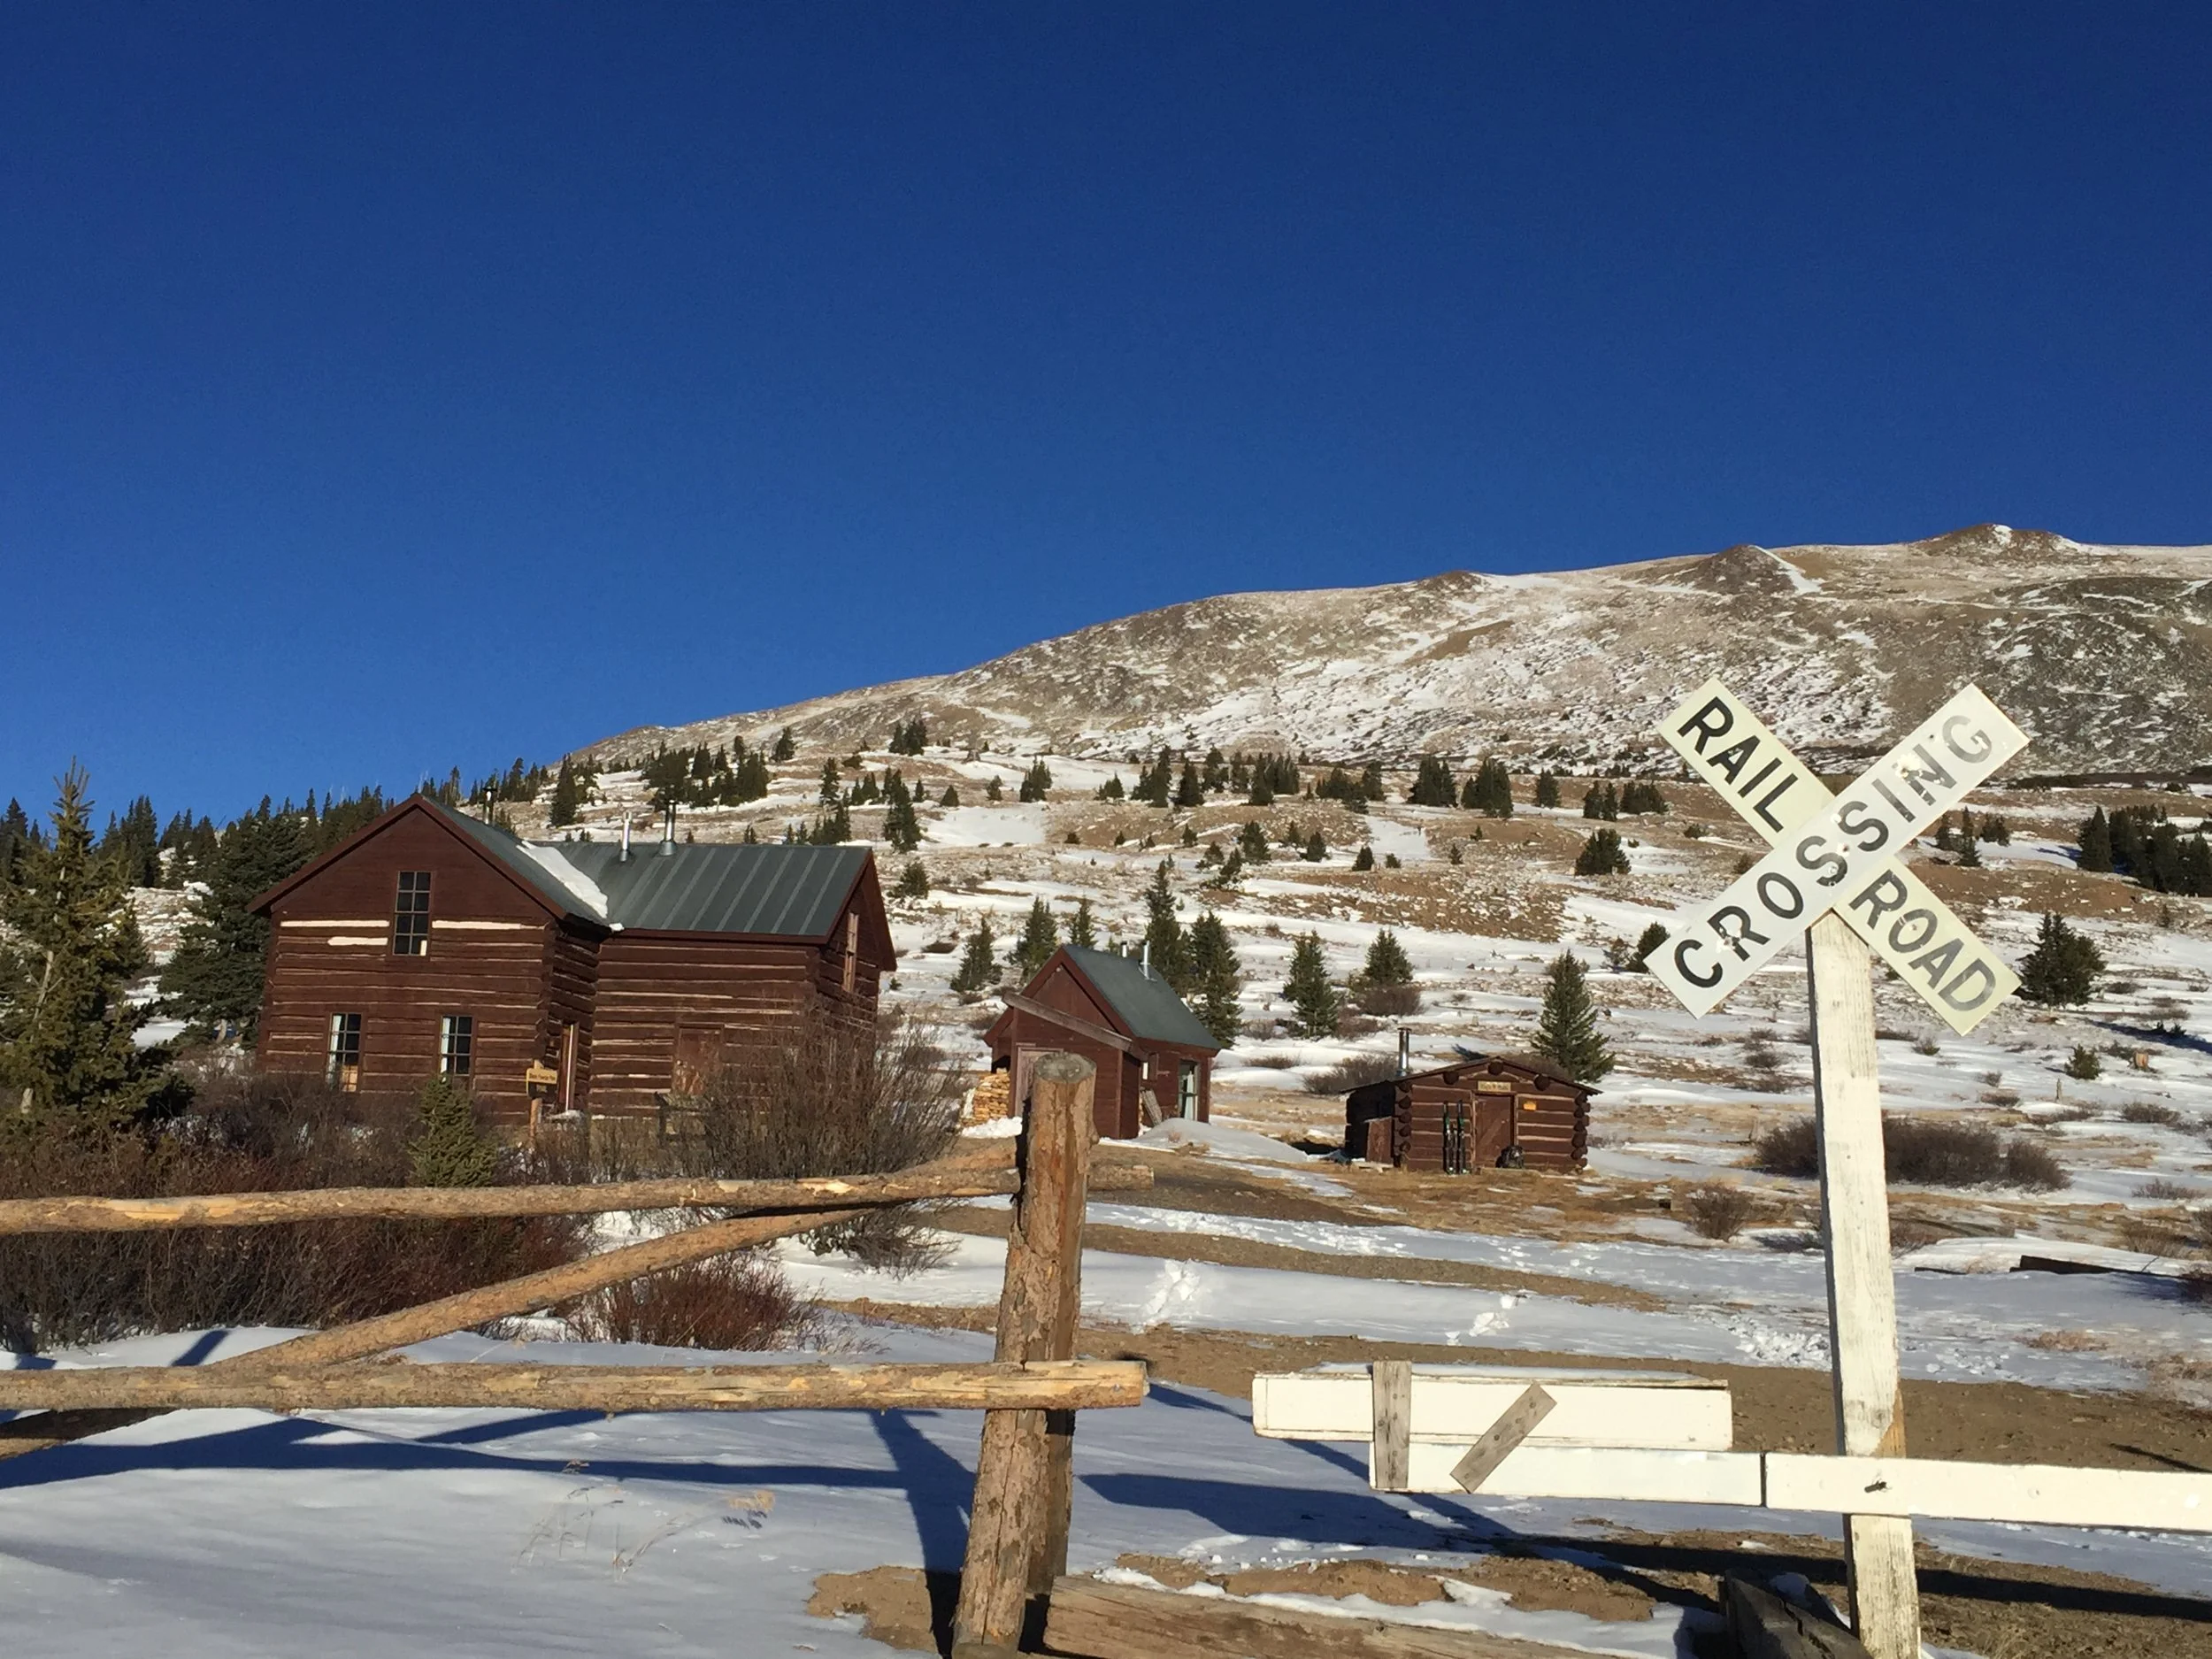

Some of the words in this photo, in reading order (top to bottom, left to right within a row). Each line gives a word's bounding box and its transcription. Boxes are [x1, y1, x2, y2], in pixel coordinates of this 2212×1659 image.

[1673, 715, 1993, 989] CROSSING
[1678, 696, 1799, 833] RAIL
[1848, 869, 1997, 1012] ROAD
